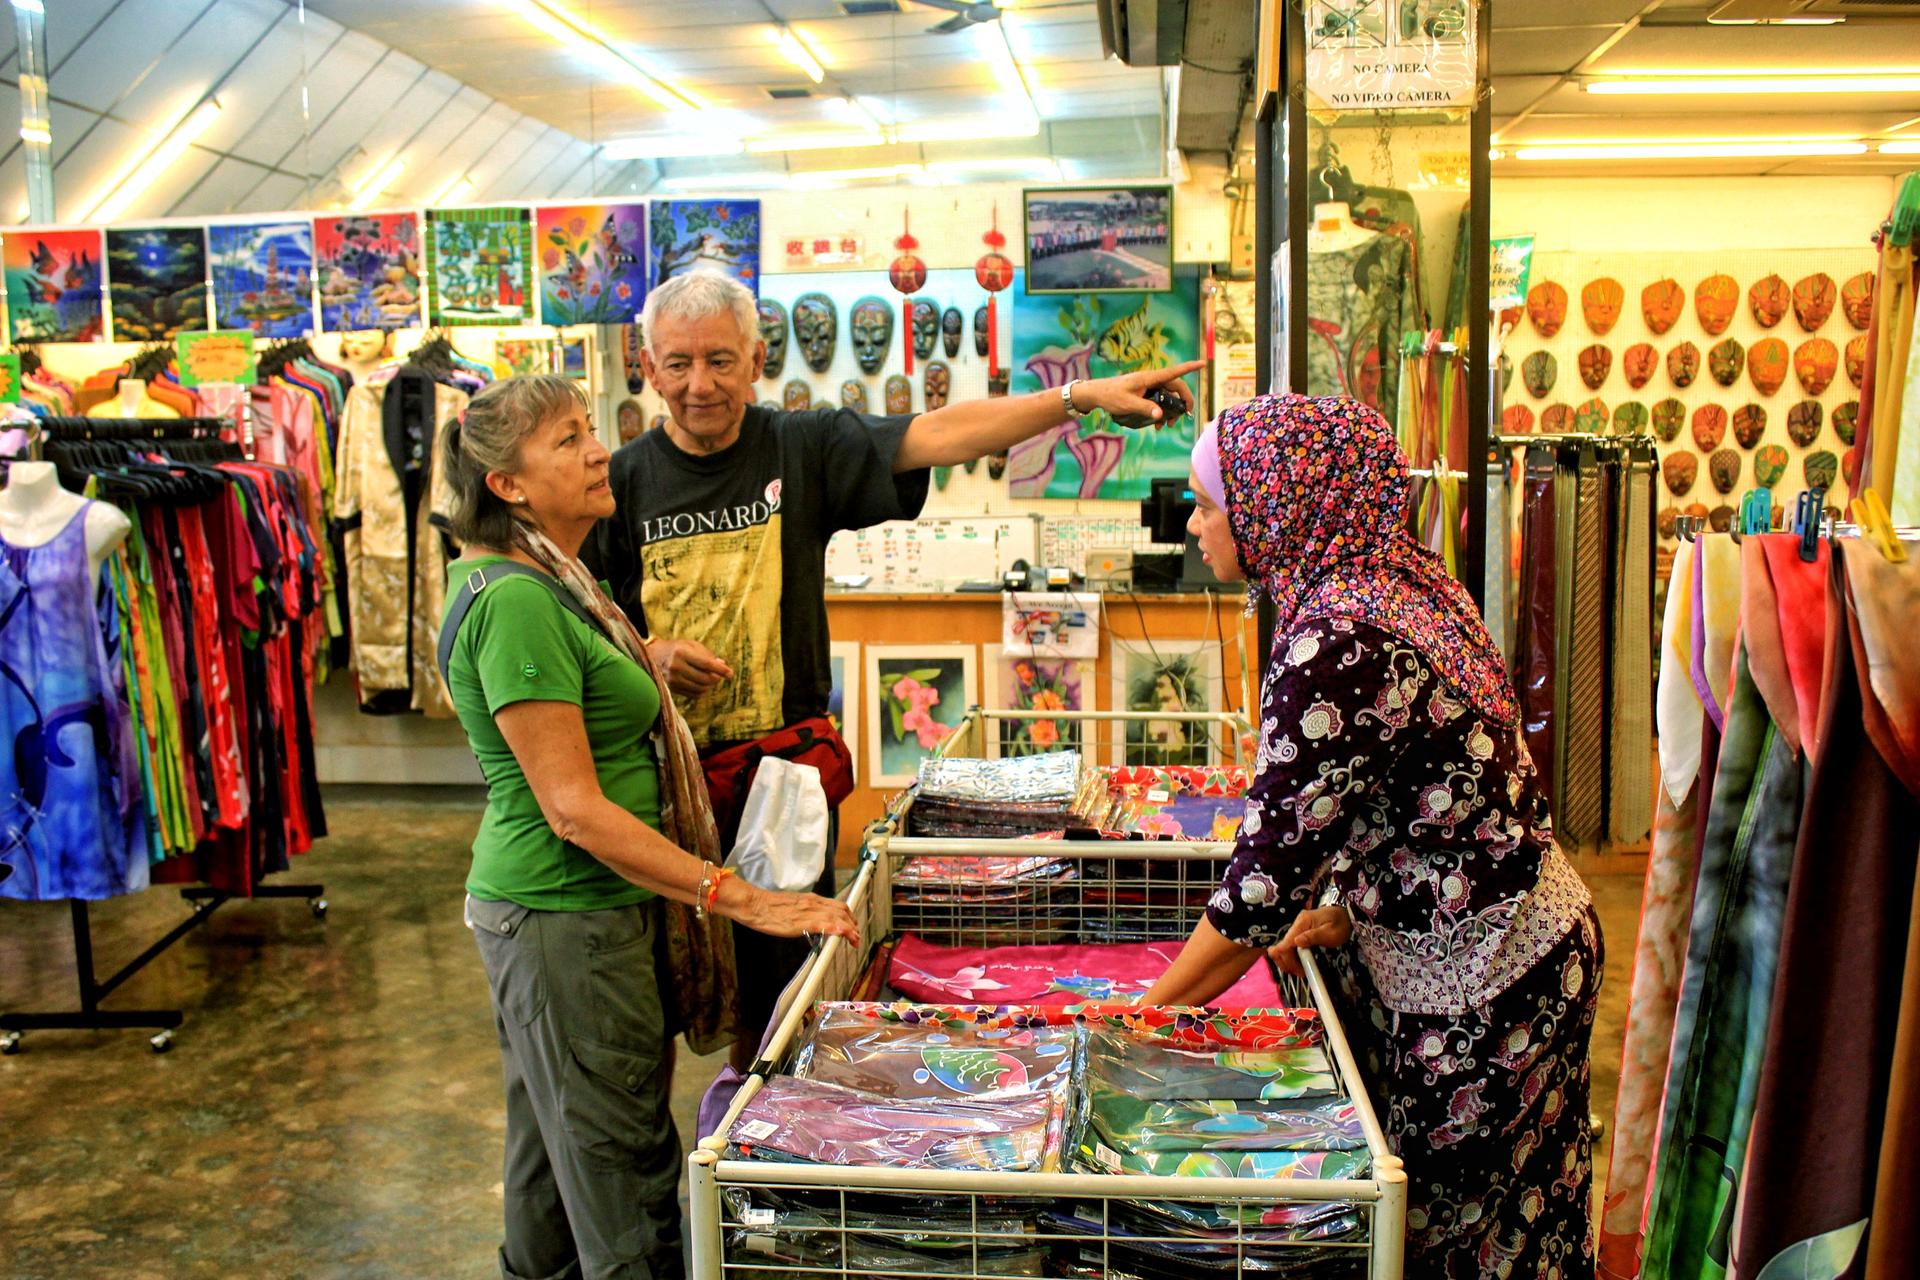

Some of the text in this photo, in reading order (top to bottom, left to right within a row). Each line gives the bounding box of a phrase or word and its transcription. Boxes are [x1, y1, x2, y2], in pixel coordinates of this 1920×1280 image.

[1353, 63, 1430, 74] NO CAMERA
[1331, 91, 1452, 103] NO VIDEO CAMERA
